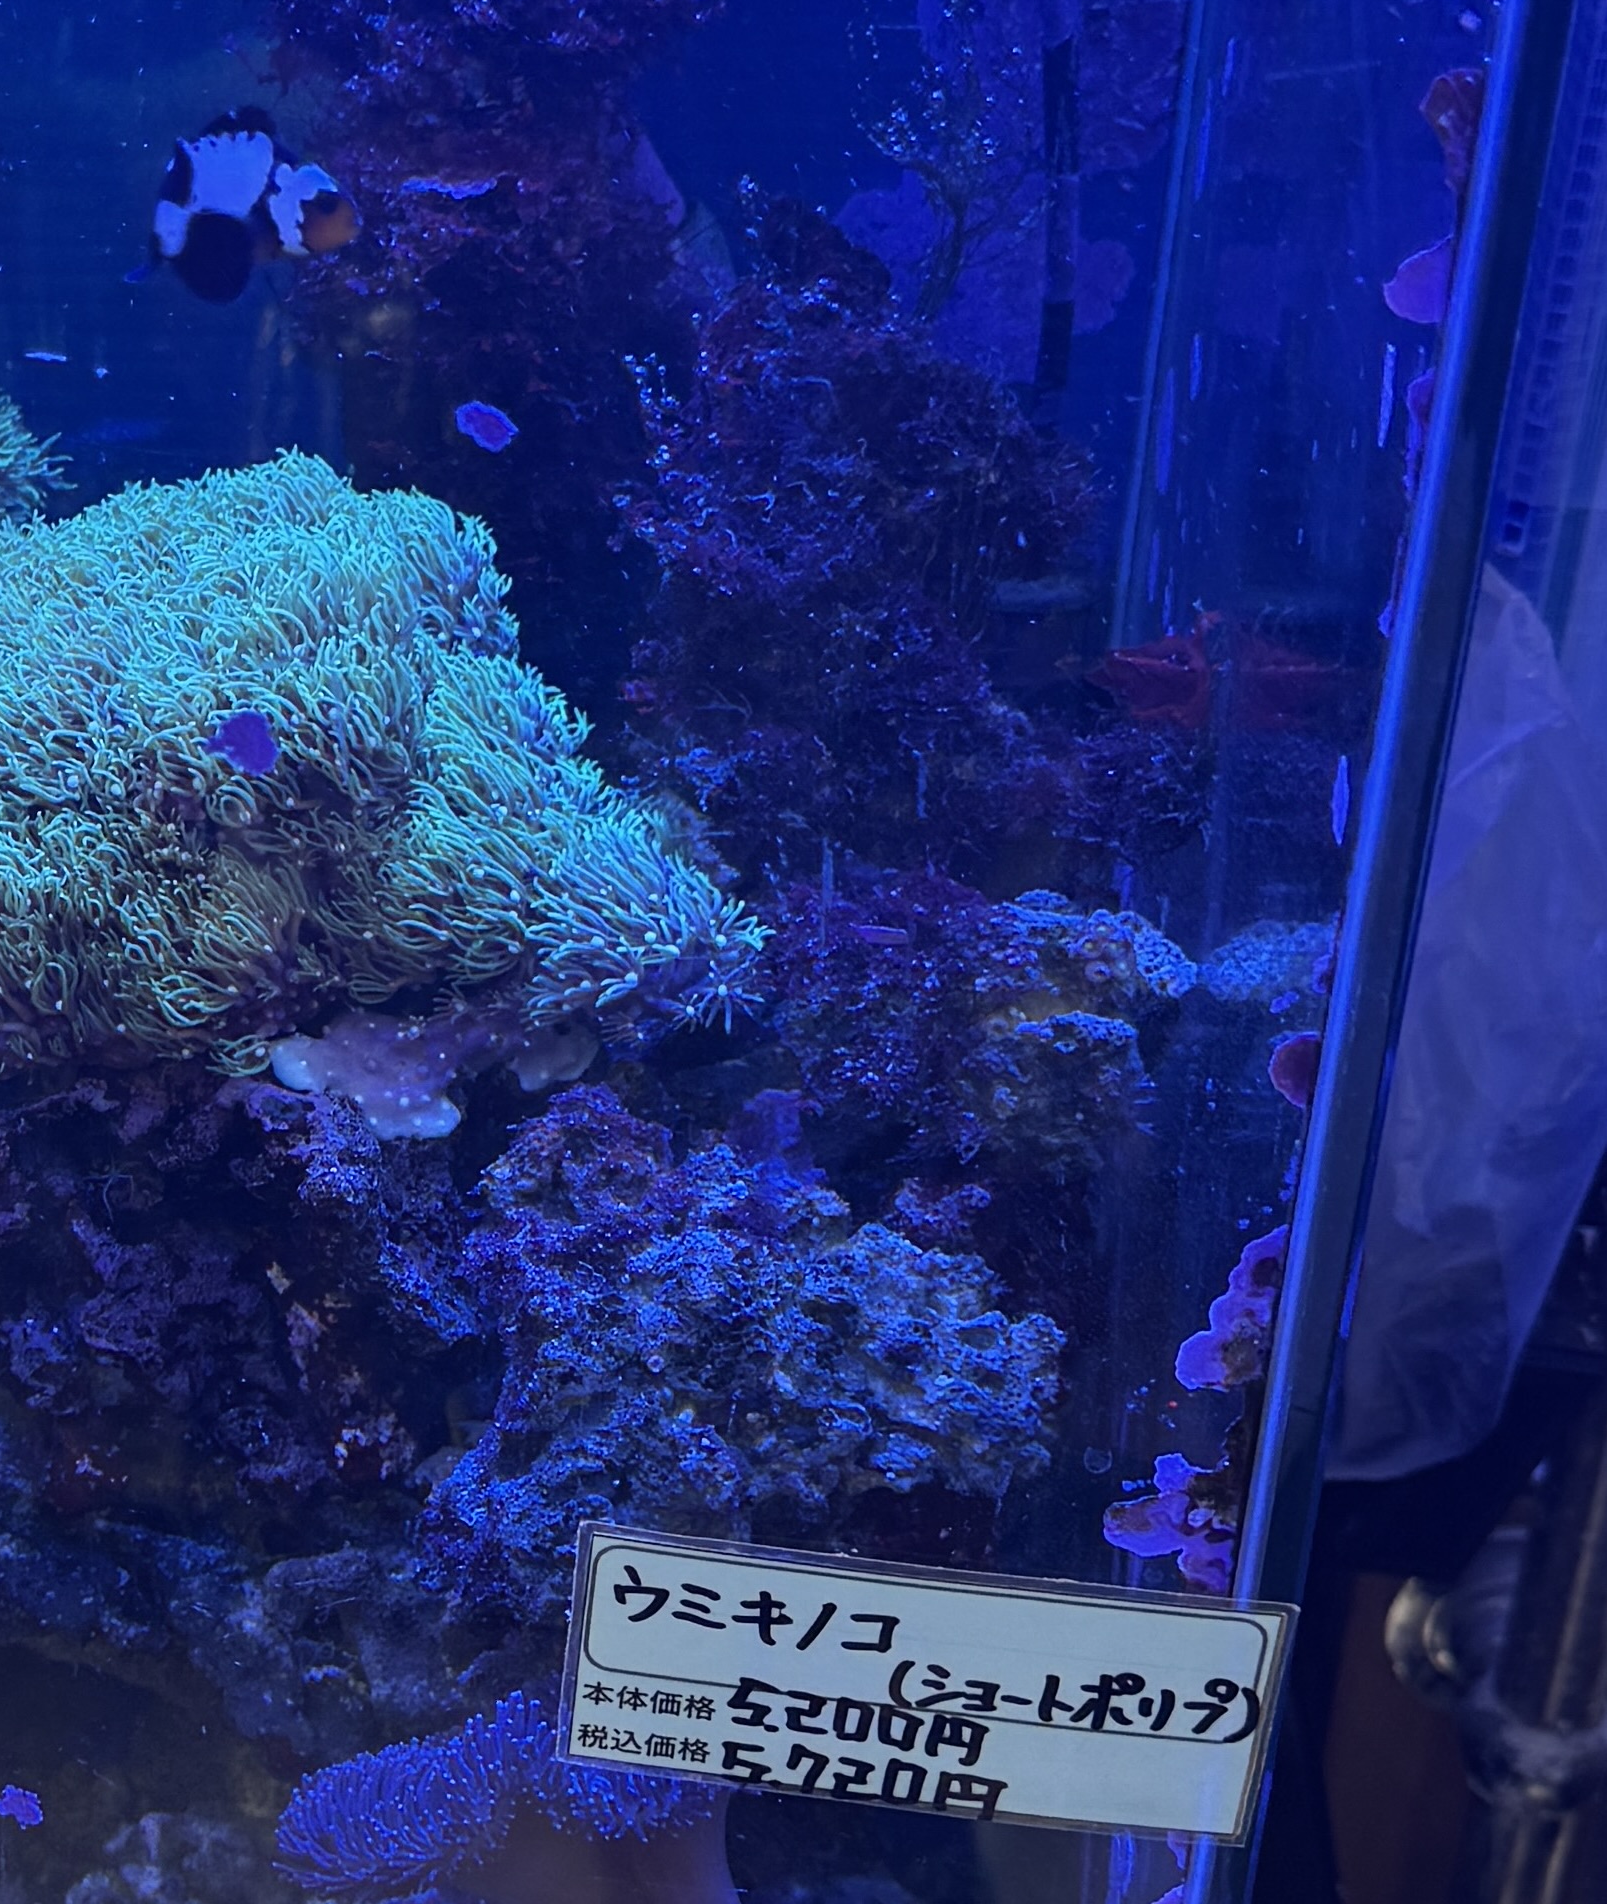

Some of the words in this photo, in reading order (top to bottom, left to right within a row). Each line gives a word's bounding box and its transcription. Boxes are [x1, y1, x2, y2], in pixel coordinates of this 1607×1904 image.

[613, 1565, 901, 1653] ウミキノコ
[583, 1682, 717, 1721] 本体価格
[577, 1723, 711, 1763] 税込価格
